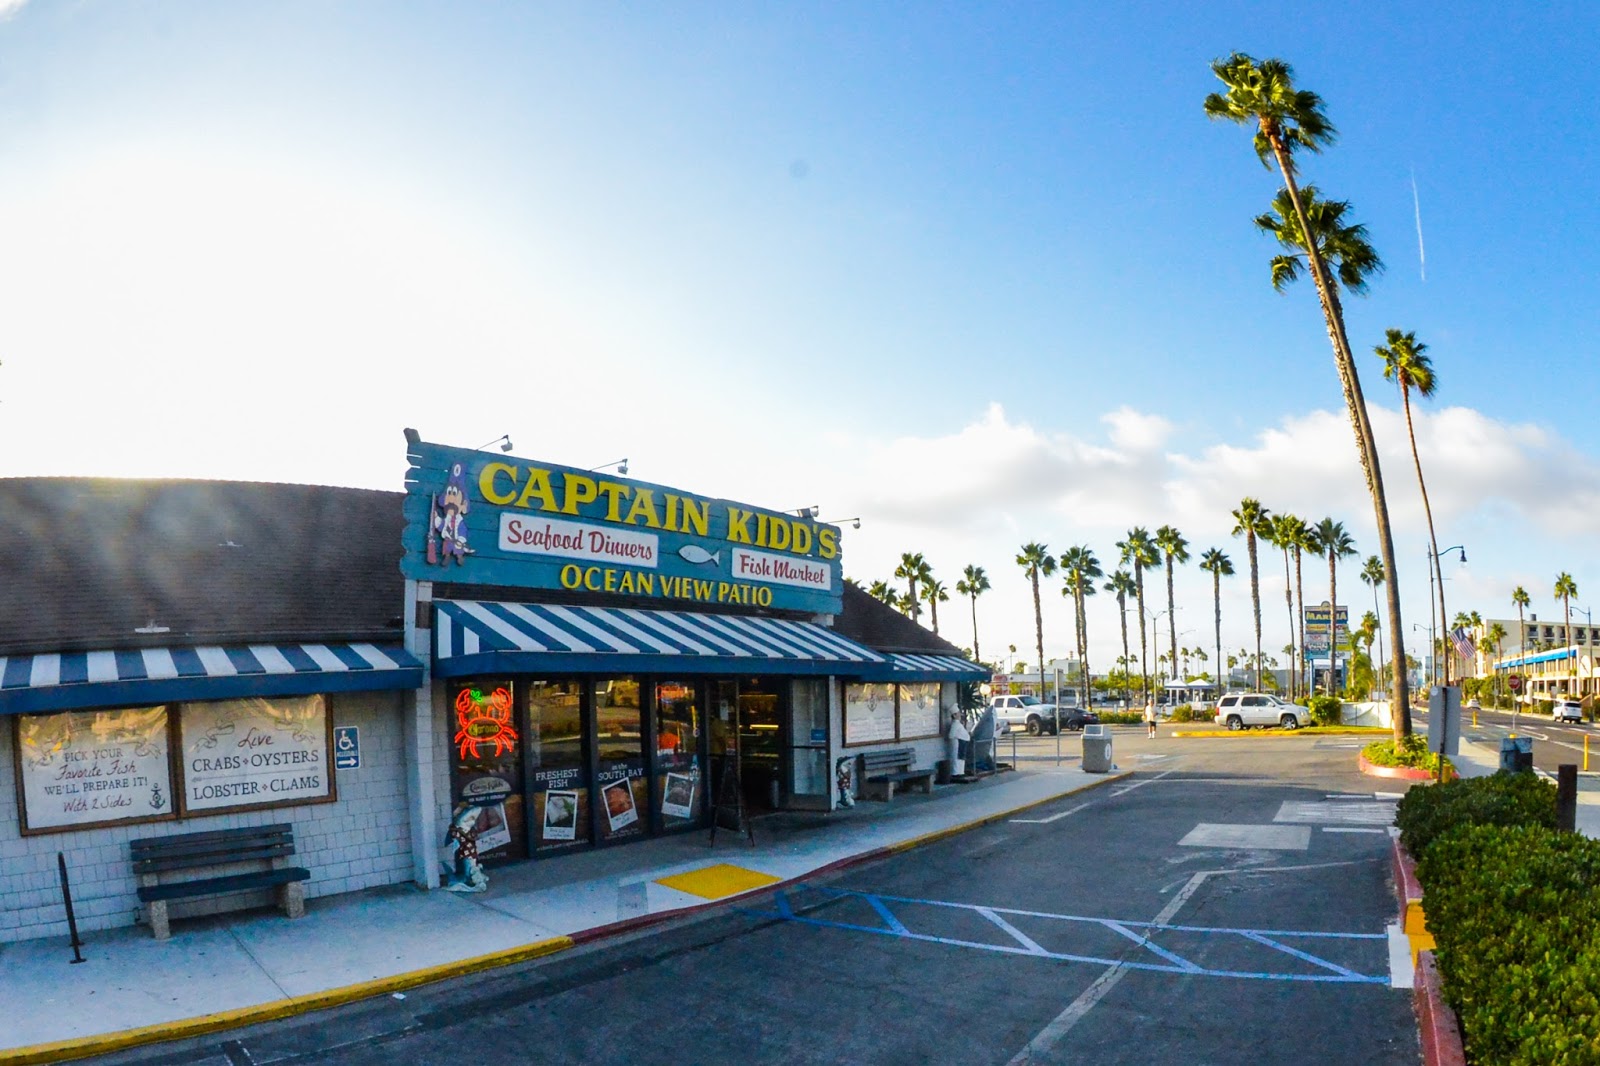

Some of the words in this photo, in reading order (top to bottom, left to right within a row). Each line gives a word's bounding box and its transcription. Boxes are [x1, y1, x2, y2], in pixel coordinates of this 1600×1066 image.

[478, 462, 711, 536] CAPTAIN
[727, 507, 836, 559] KIDD'S
[507, 520, 583, 550] Seafood
[588, 531, 652, 560] Dinners
[740, 554, 770, 575] Fish
[773, 560, 825, 583] Market
[560, 564, 653, 594] OCEAN
[660, 575, 713, 600] VIEW
[718, 582, 772, 607] PATIO
[237, 727, 274, 749] Live
[64, 751, 88, 762] PICK
[93, 748, 123, 760] YOUR
[192, 756, 241, 772] CRABS
[251, 750, 319, 767] OYSTERS
[55, 762, 102, 780] Favorite
[106, 760, 137, 776] Fish
[535, 769, 579, 781] FRESHEST
[598, 770, 626, 781] SOUTH
[628, 768, 644, 777] BAY
[44, 784, 79, 795] WE'LL
[83, 778, 130, 793] PREPARE
[133, 776, 148, 787] IT!
[193, 782, 259, 800] LOBSTER
[270, 775, 320, 792] CLAMS
[548, 779, 568, 789] FISH
[63, 797, 88, 813] With
[91, 798, 99, 809] 2
[100, 794, 133, 809] Sides
